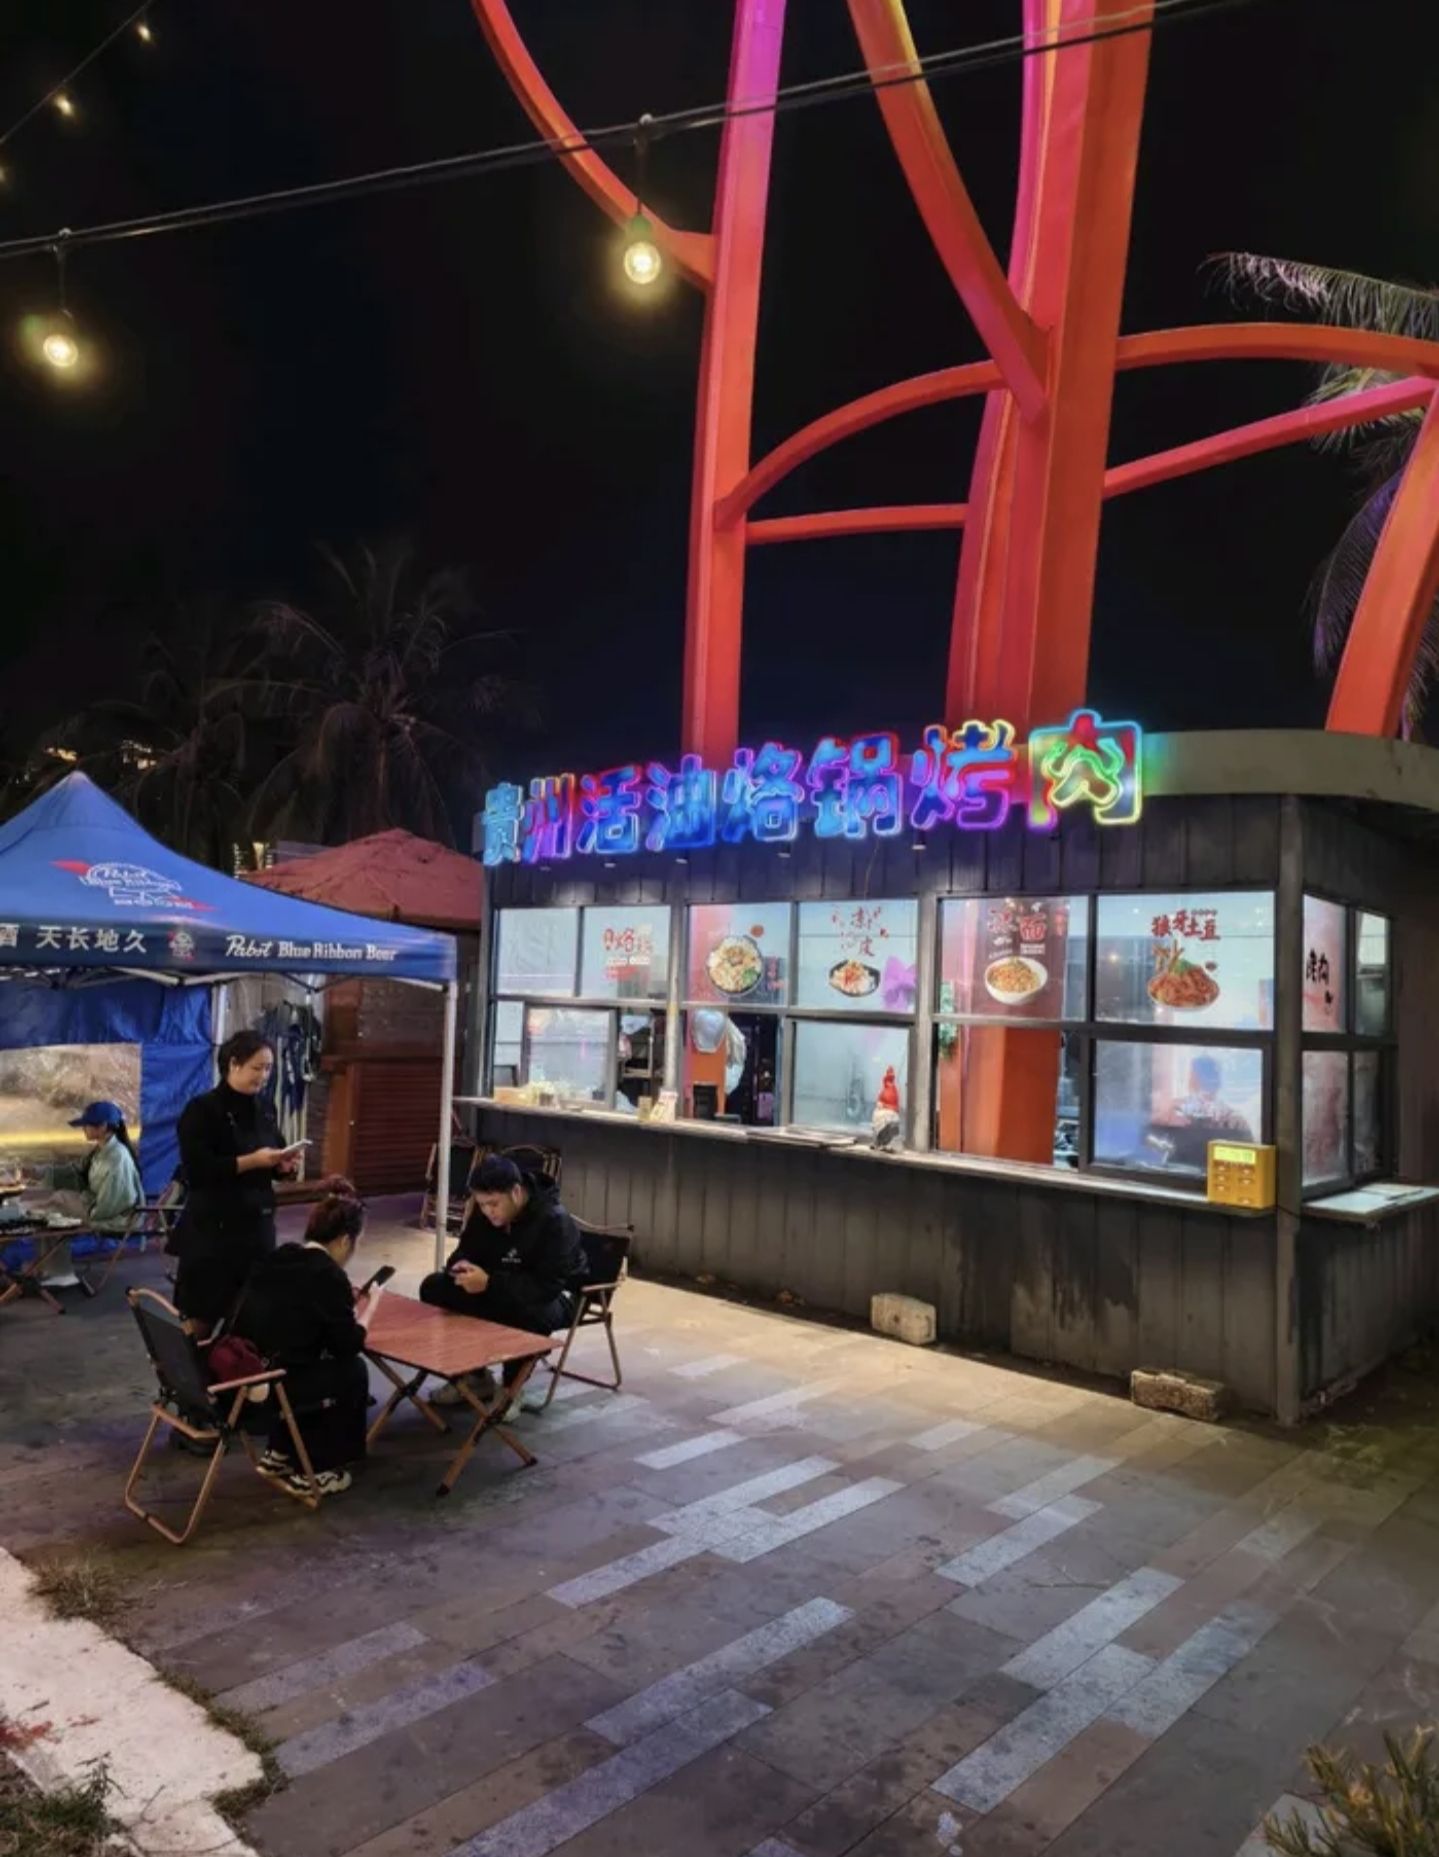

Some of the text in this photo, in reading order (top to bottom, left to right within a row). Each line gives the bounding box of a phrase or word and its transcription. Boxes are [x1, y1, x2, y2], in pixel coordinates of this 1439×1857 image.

[35, 925, 147, 953] 天长地久
[225, 935, 397, 961] Pabst Blue Ribbon Beer
